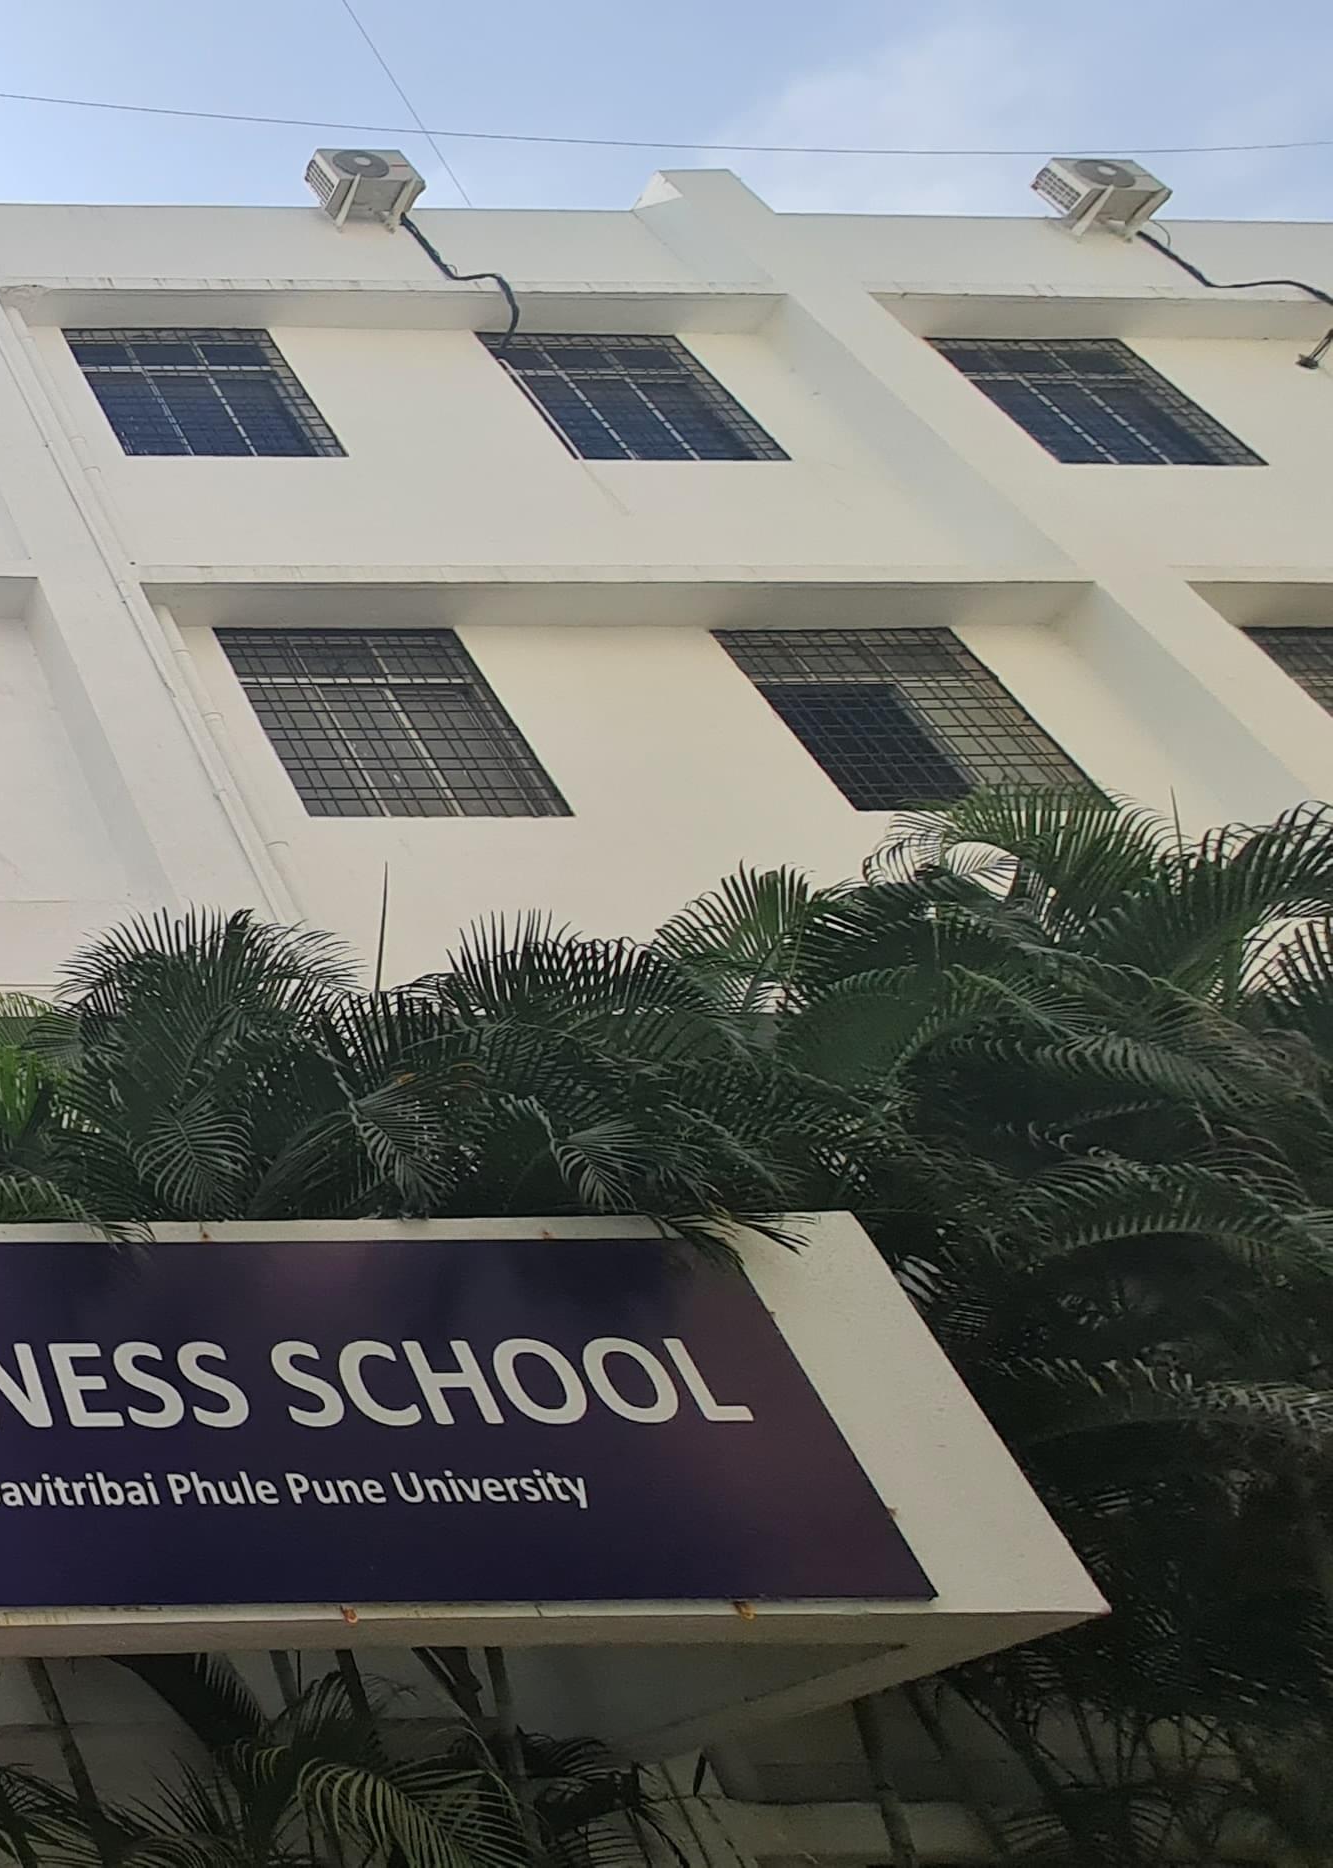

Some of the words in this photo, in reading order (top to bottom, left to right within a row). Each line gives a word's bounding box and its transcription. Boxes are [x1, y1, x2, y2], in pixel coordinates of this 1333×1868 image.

[269, 1337, 755, 1428] SCHOOL
[166, 1471, 280, 1506] Phule
[286, 1472, 387, 1505] Pune
[391, 1469, 589, 1509] University
